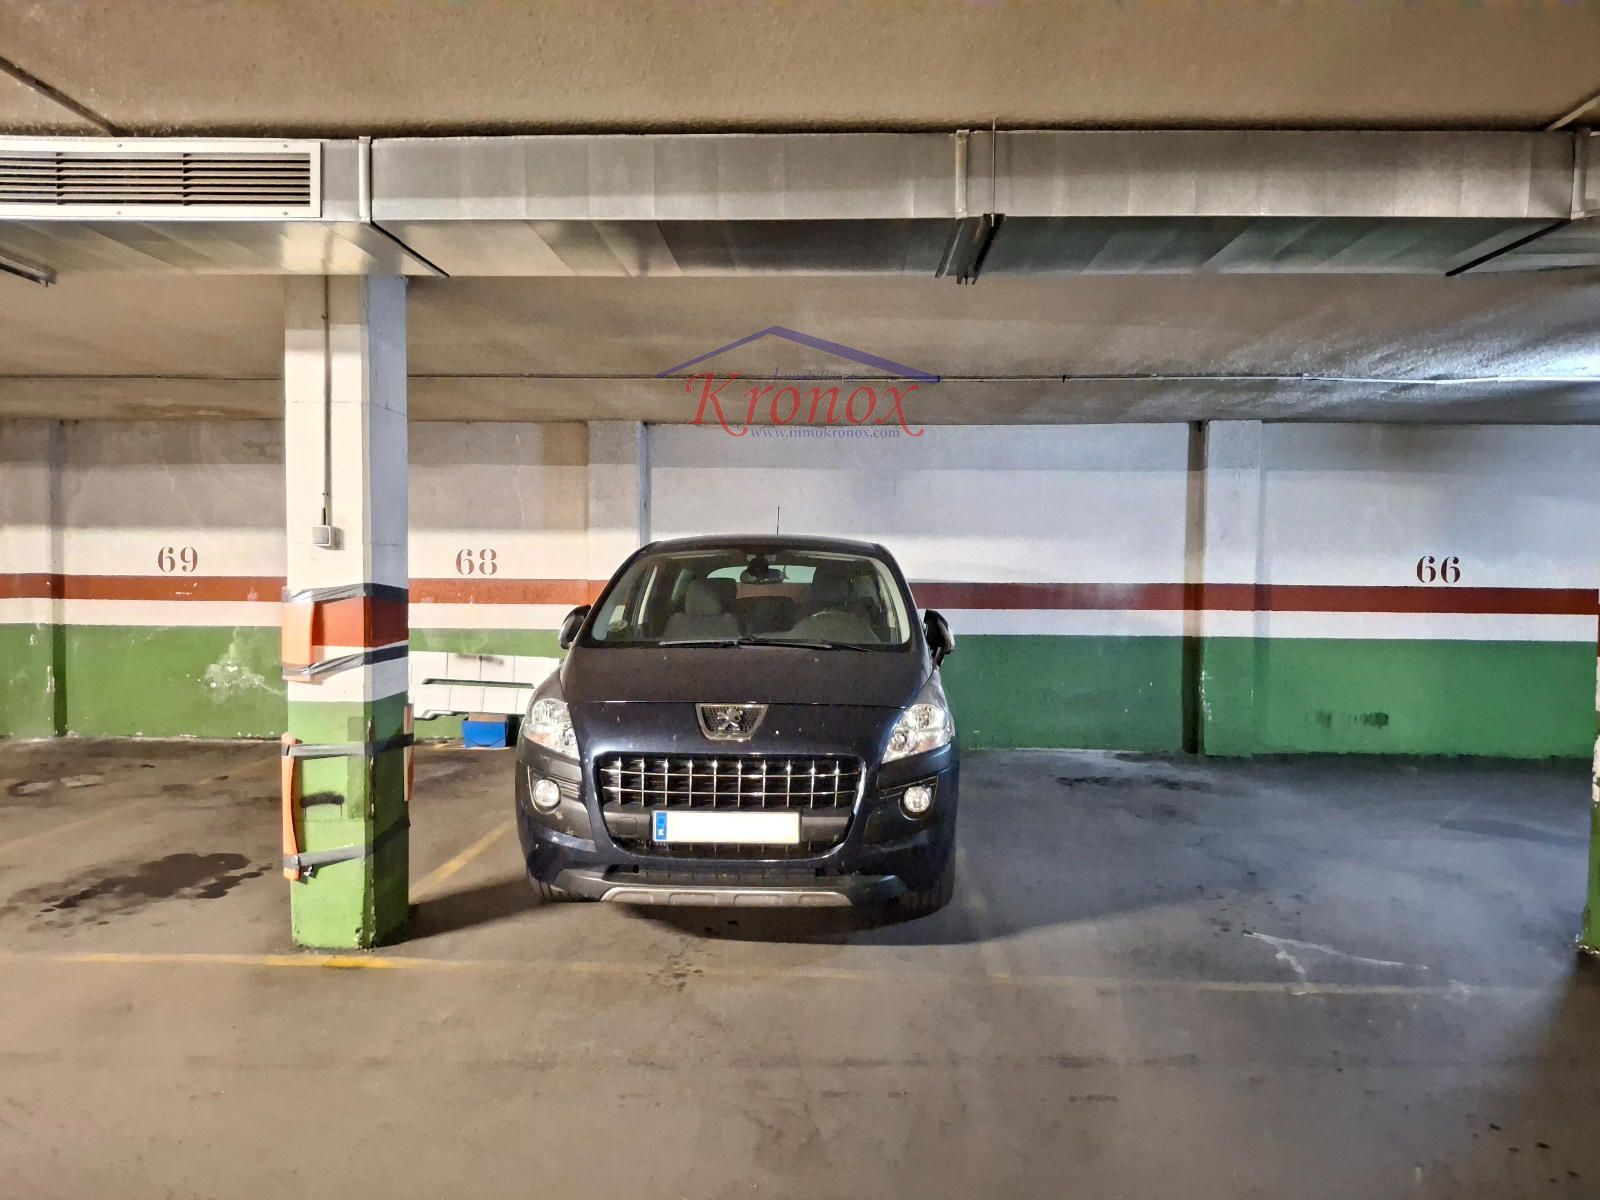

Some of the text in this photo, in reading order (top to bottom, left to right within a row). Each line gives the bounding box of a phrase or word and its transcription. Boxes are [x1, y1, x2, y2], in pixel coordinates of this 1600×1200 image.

[157, 546, 198, 573] 69
[456, 548, 498, 575] 68
[1416, 555, 1461, 583] 66
